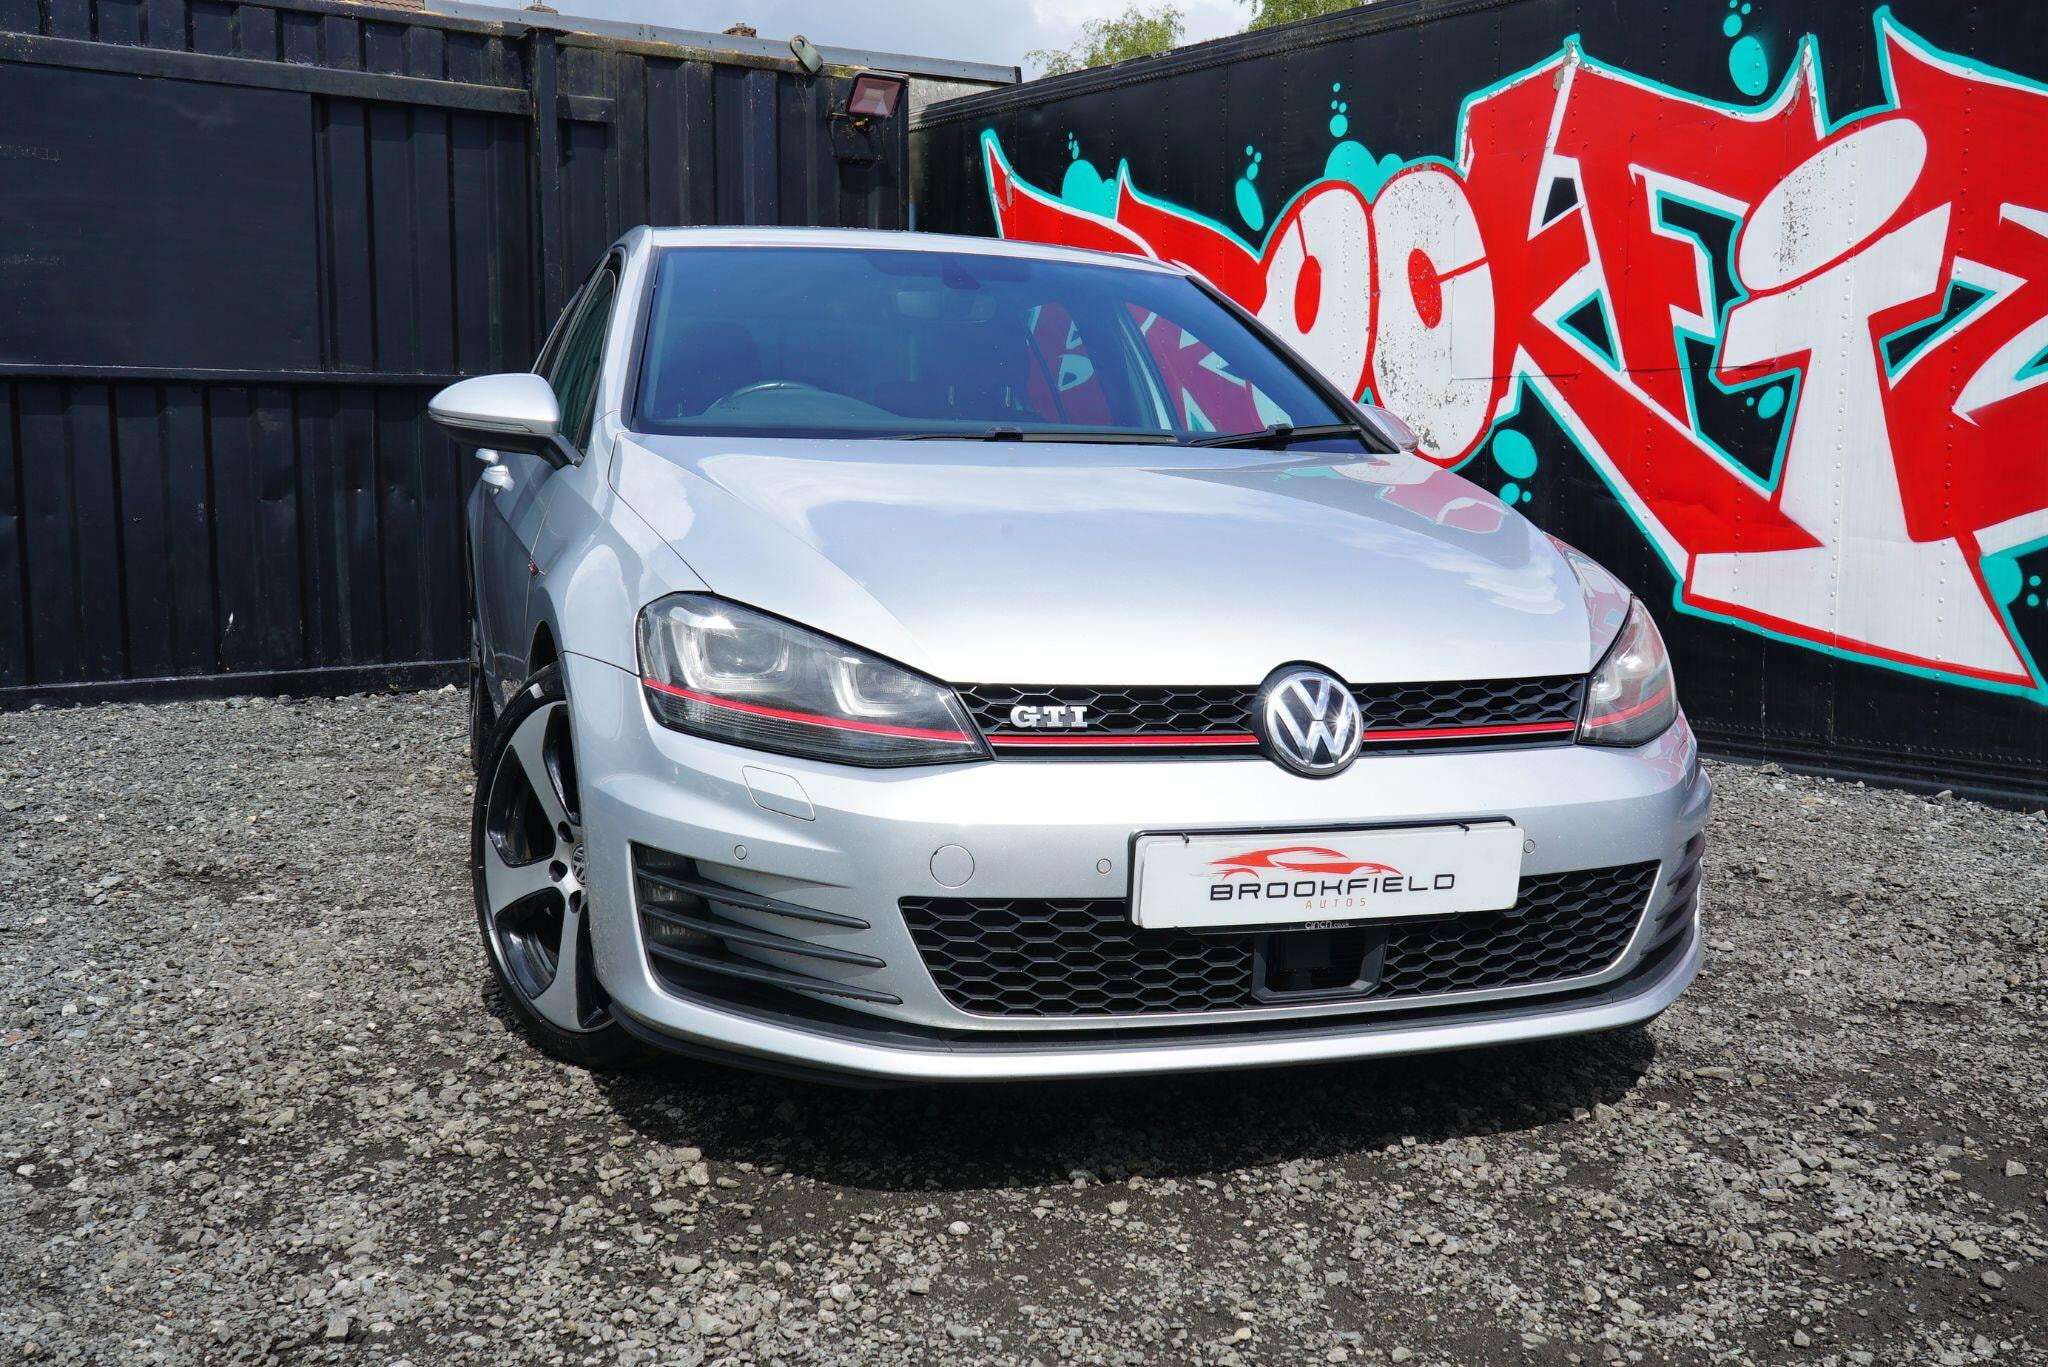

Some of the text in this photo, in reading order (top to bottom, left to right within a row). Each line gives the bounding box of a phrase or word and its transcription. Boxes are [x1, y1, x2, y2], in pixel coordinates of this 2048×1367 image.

[1009, 705, 1088, 730] GTI
[1268, 674, 1360, 766] VW
[1210, 874, 1456, 900] BROOKFIELD
[1305, 897, 1366, 909] AUTOS
